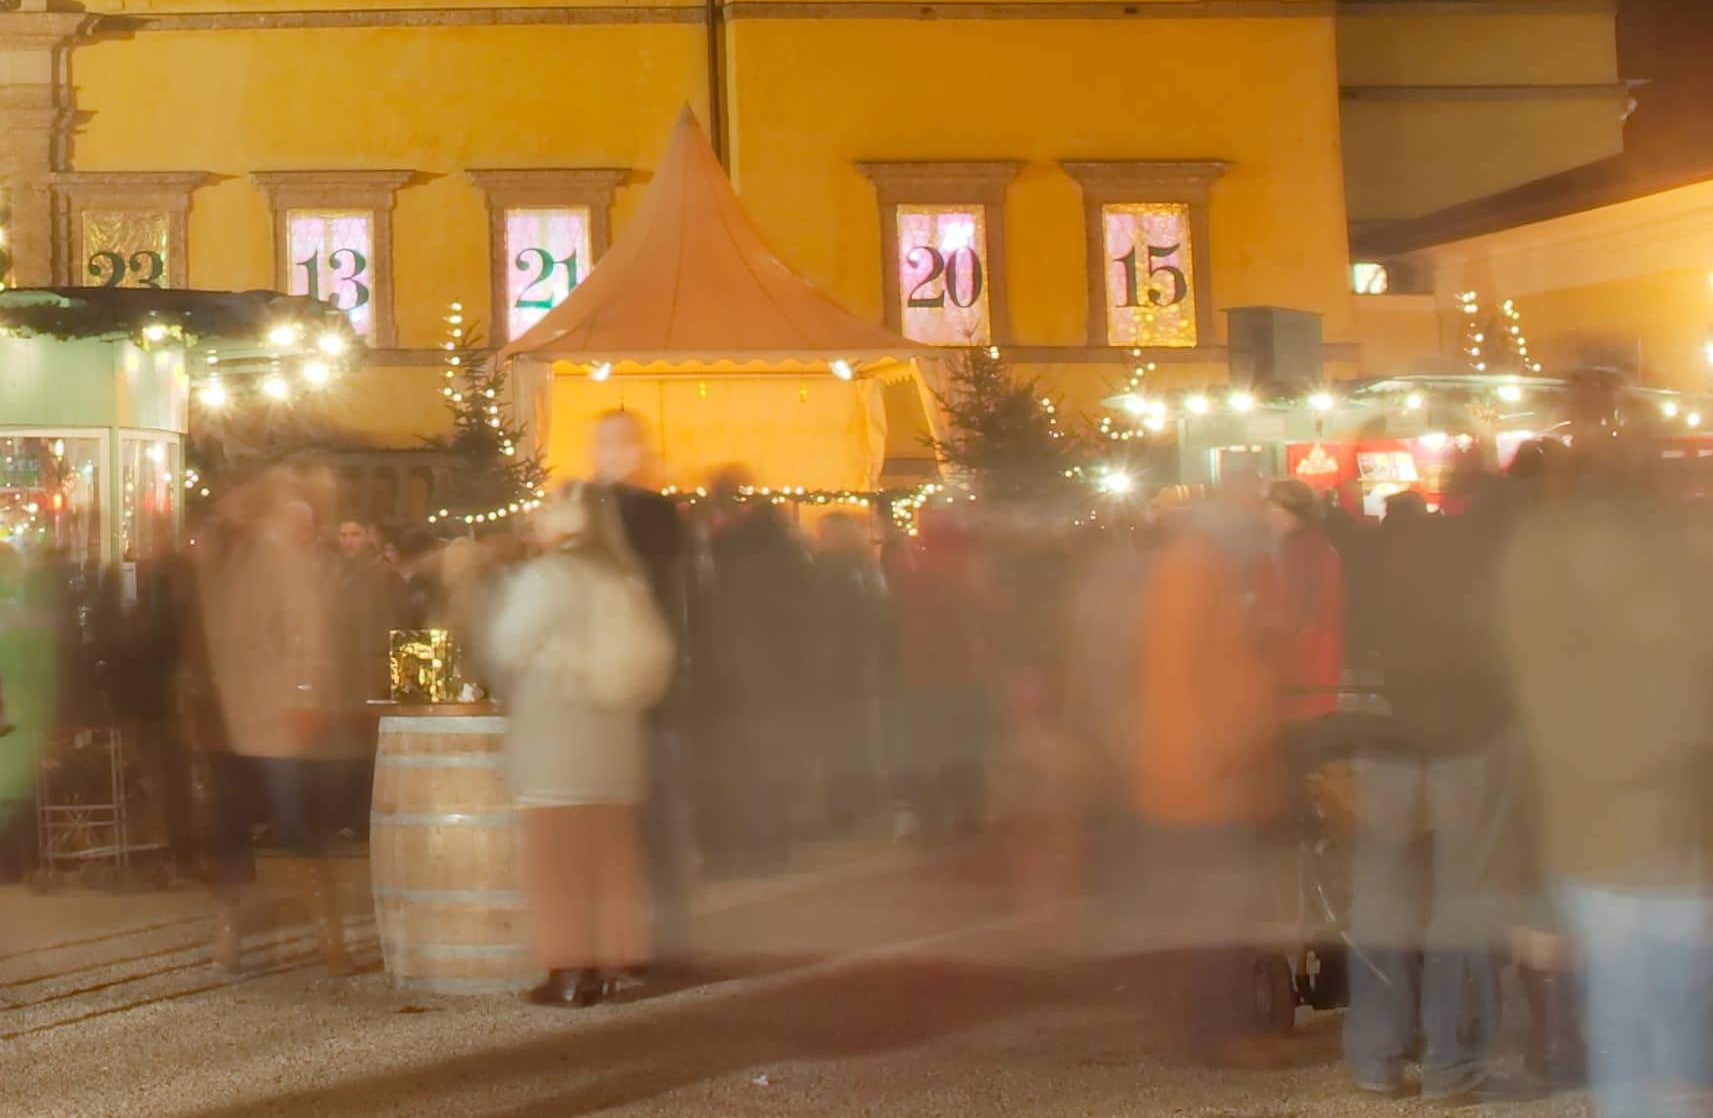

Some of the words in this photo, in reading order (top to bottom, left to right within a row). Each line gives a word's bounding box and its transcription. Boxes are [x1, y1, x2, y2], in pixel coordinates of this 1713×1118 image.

[88, 251, 164, 289] 23
[296, 248, 369, 311] 13
[515, 248, 580, 309] 21
[907, 245, 983, 309] 20
[1114, 243, 1188, 308] 15
